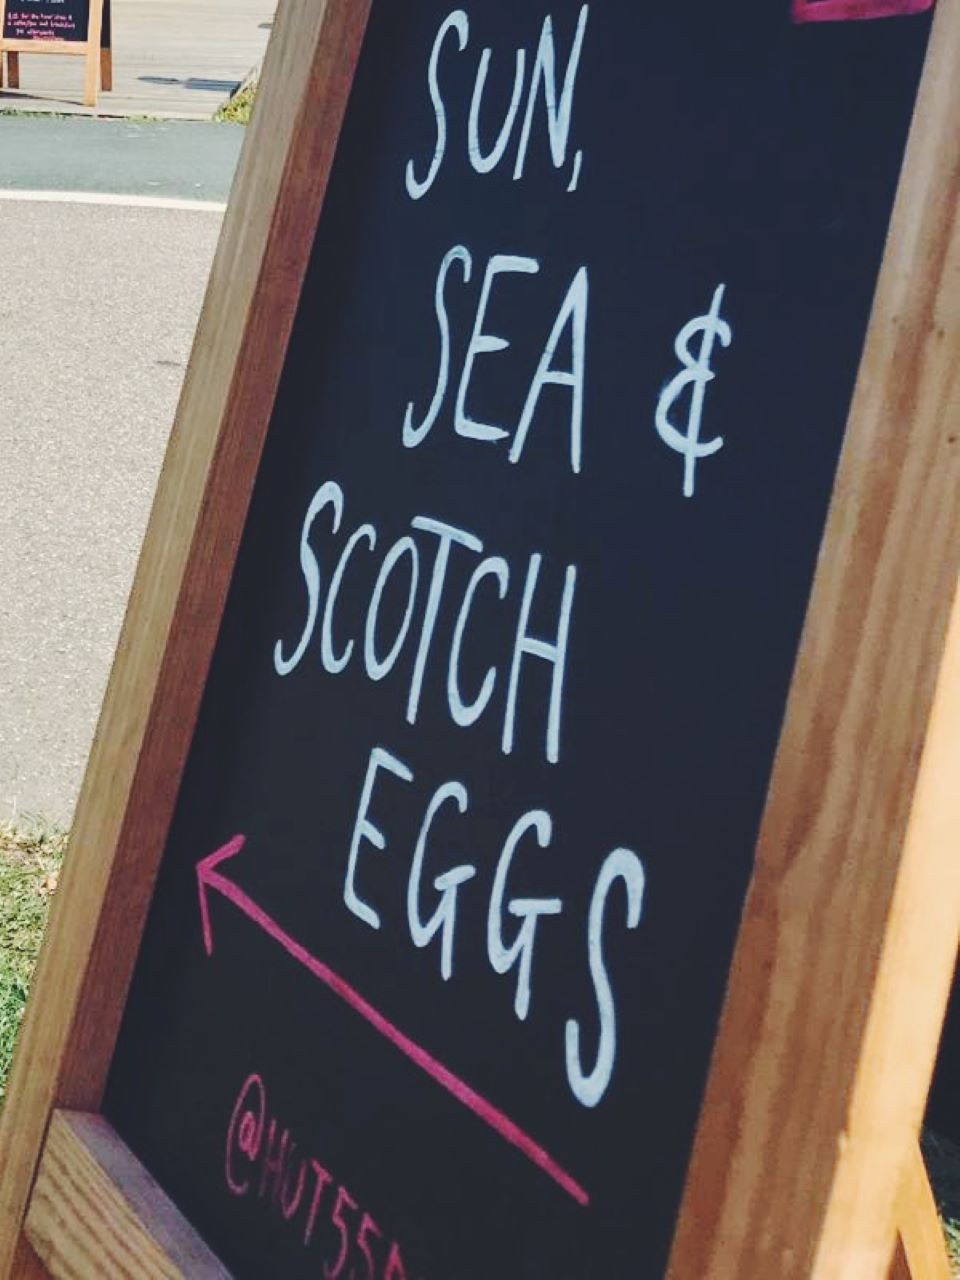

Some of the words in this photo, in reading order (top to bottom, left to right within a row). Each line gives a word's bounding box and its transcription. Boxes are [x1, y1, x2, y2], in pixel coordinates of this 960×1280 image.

[406, 4, 588, 200] SUN,
[402, 244, 590, 474] SEA
[655, 283, 732, 498] &
[273, 480, 577, 763] SCOTCH
[343, 746, 645, 1108] EGGS
